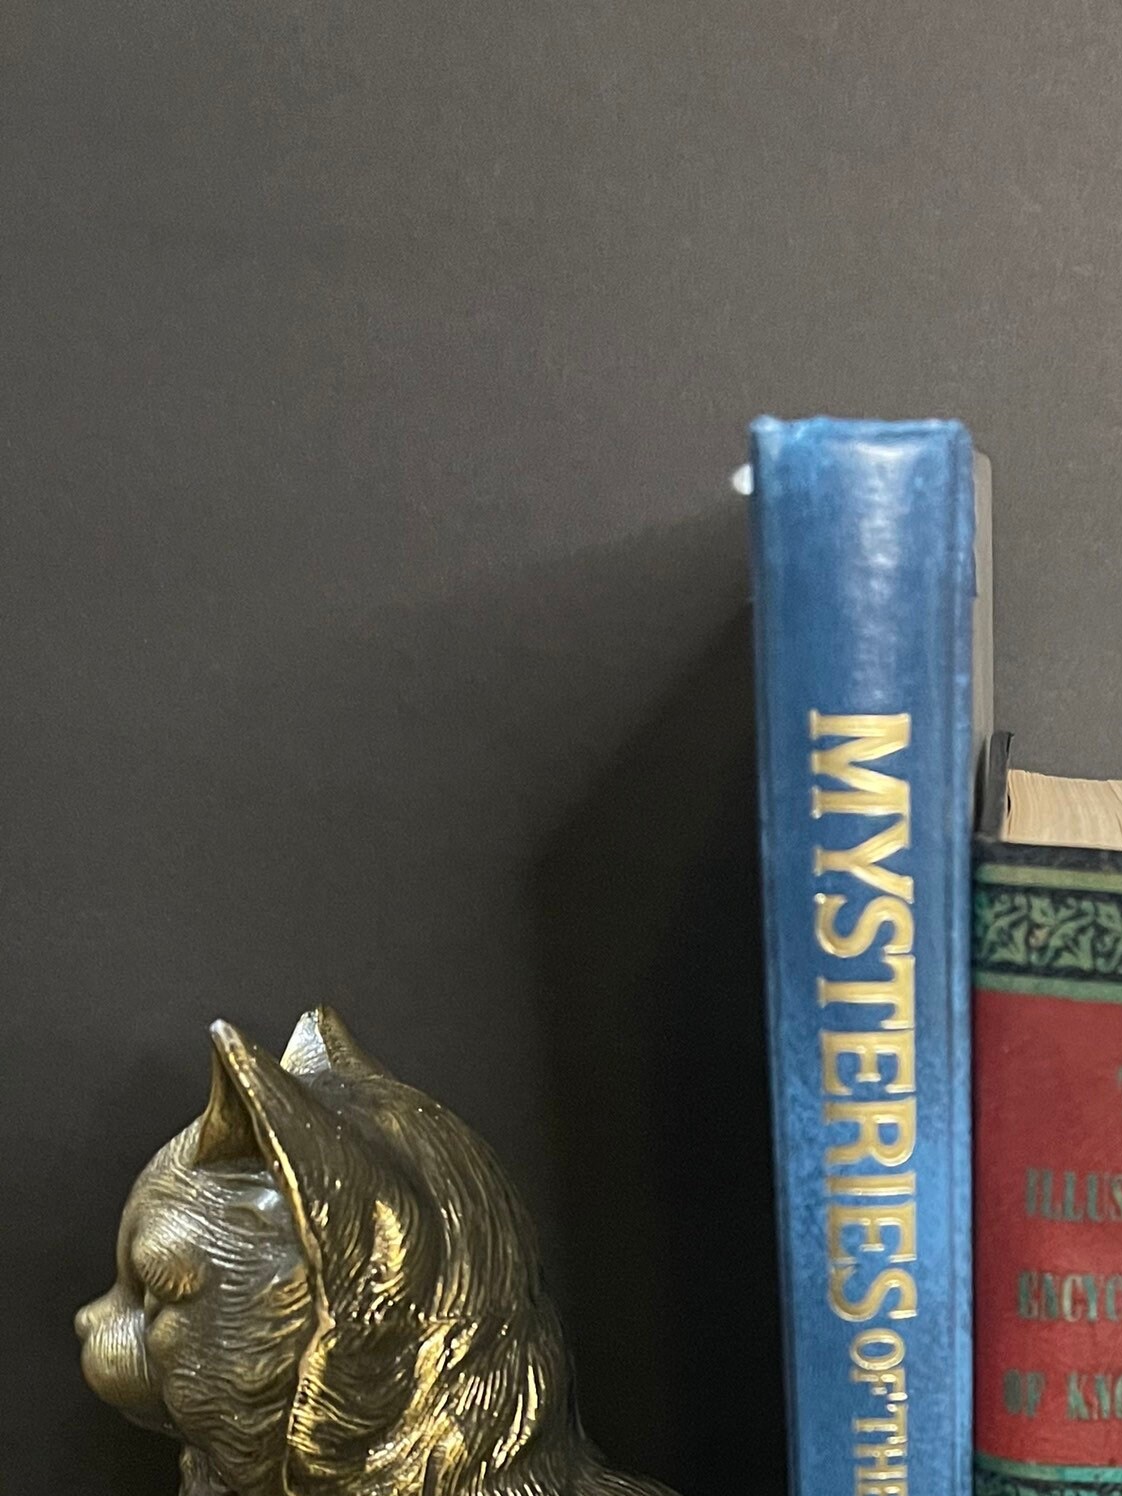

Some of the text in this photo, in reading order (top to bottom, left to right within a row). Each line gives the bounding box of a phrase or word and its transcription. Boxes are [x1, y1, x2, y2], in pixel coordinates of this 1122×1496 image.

[810, 709, 917, 1323] MYSTERIES
[850, 1328, 908, 1401] OF
[1003, 1370, 1046, 1418] OF
